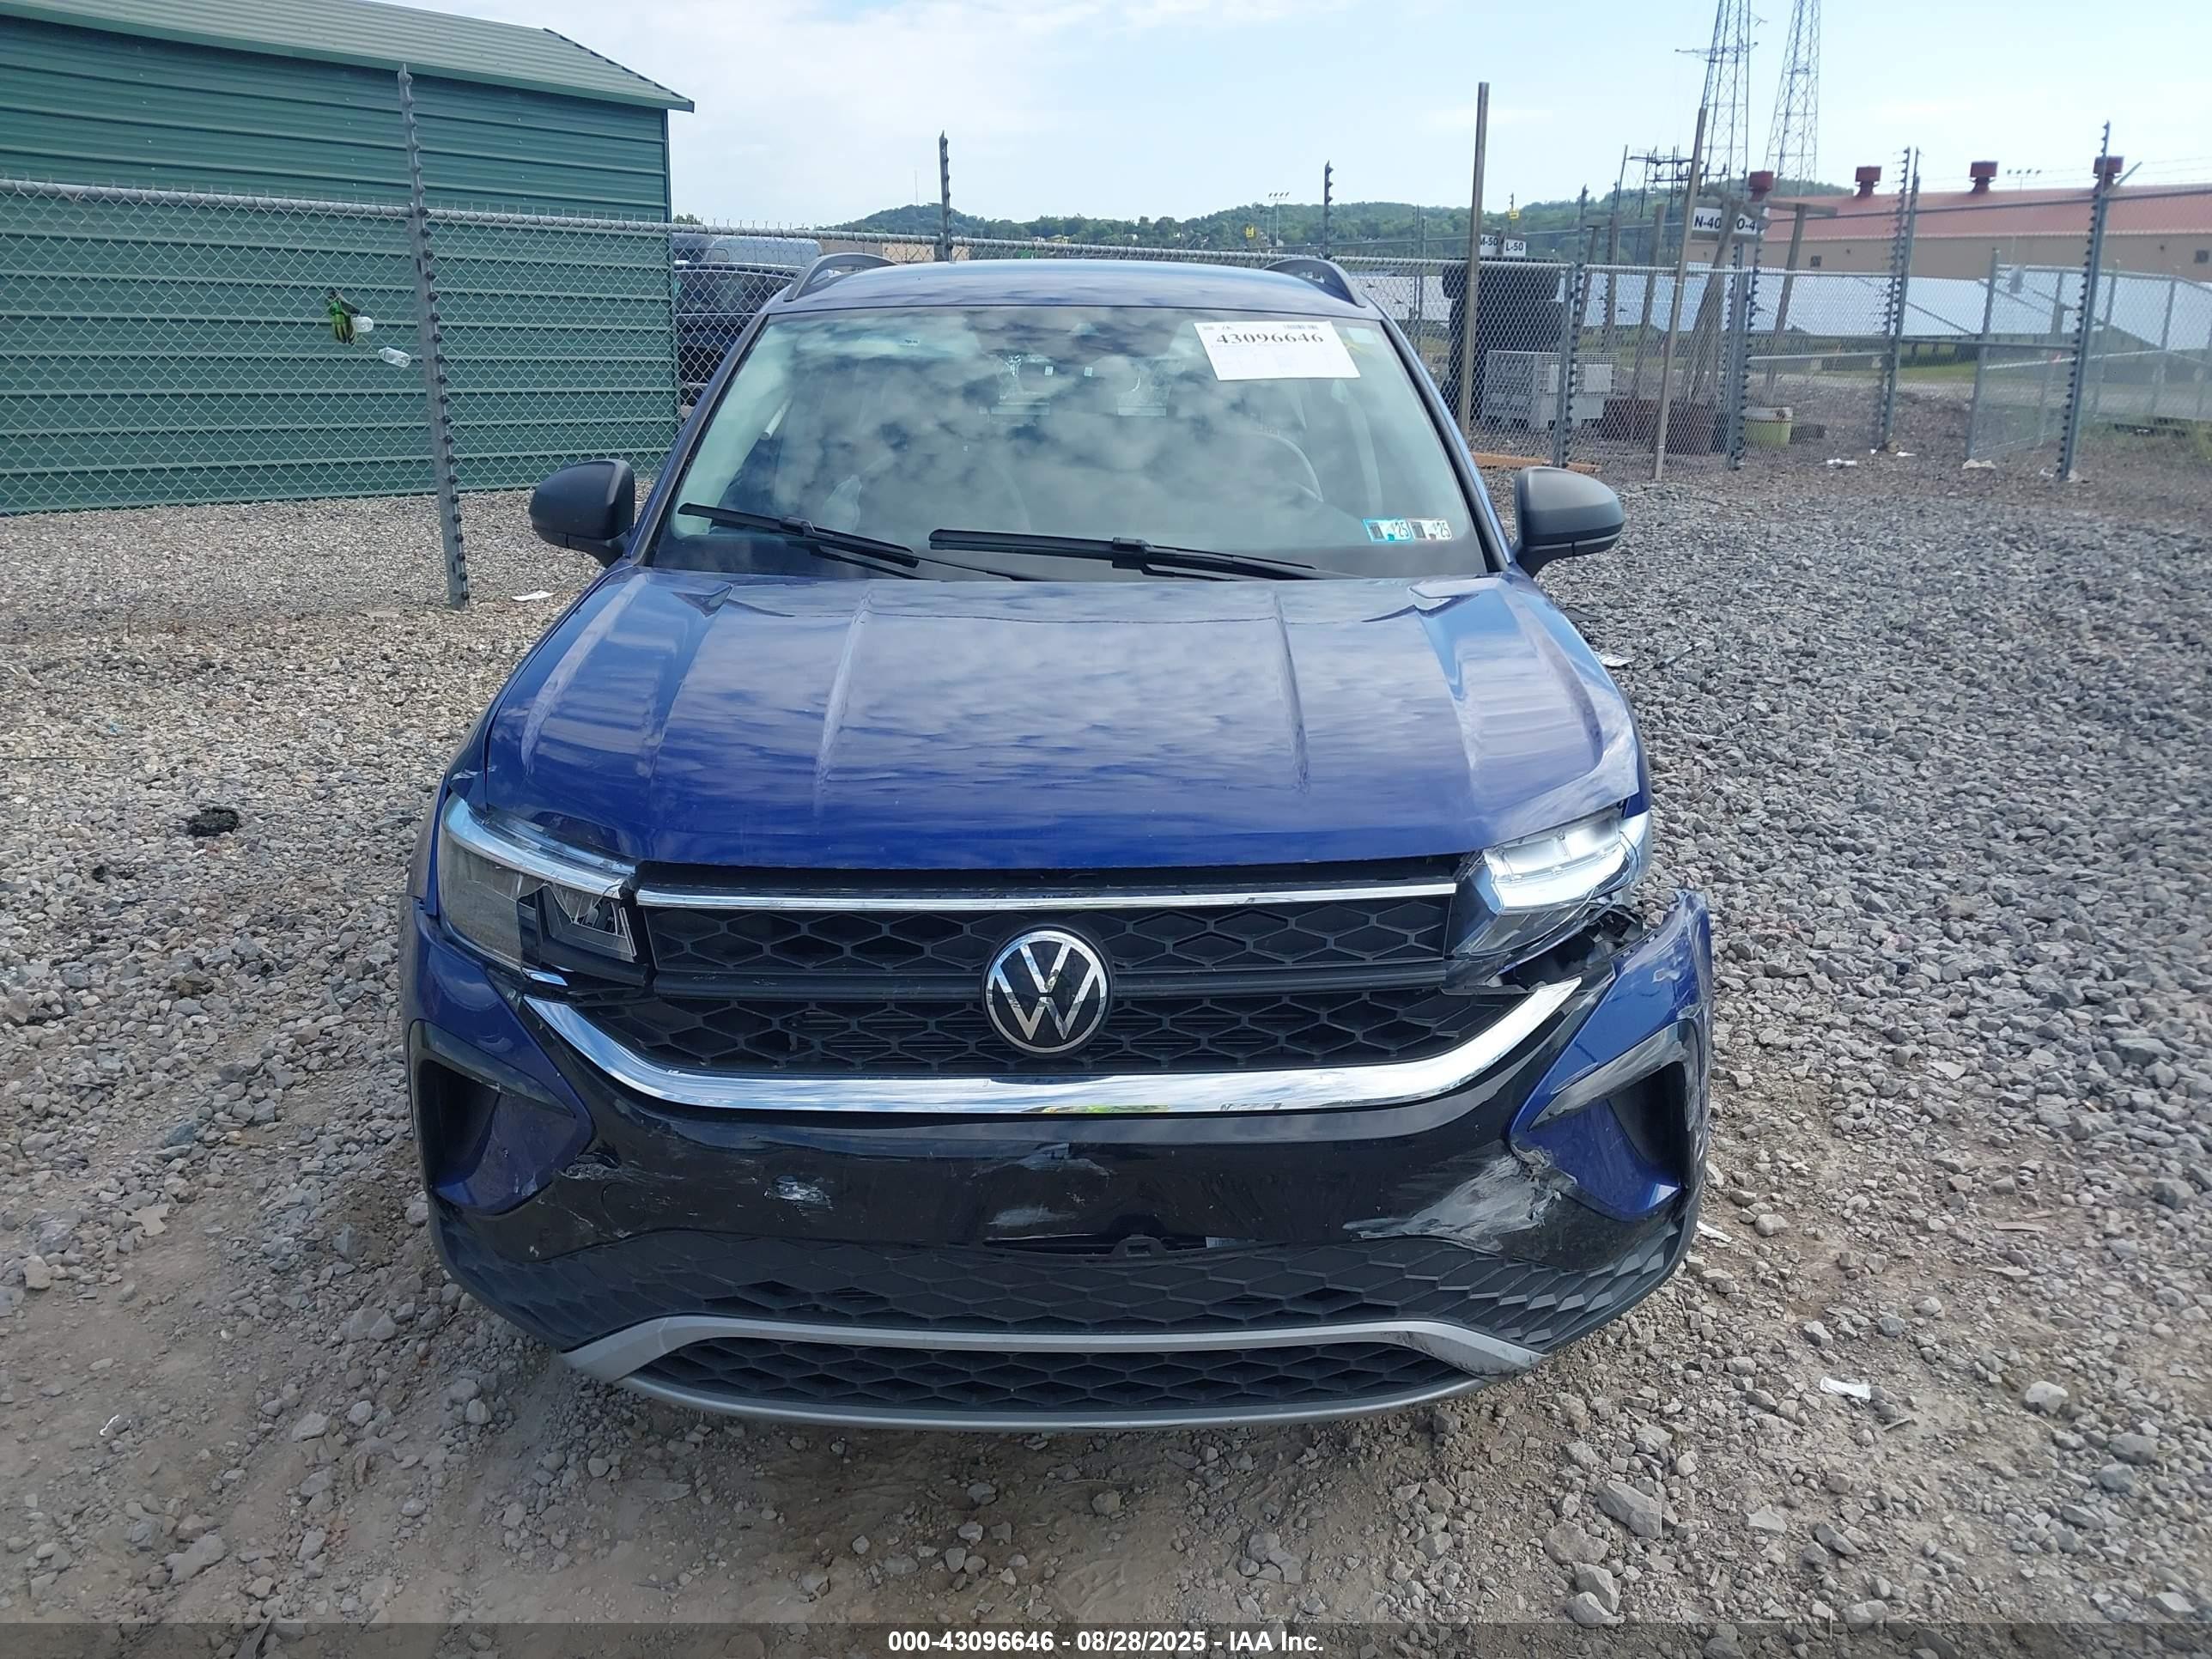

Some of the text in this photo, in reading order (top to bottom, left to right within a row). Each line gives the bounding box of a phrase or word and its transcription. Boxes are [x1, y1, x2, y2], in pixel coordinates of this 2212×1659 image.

[1694, 216, 1722, 229] N-40
[1505, 241, 1524, 252] L-50
[1216, 332, 1324, 343] 43096646
